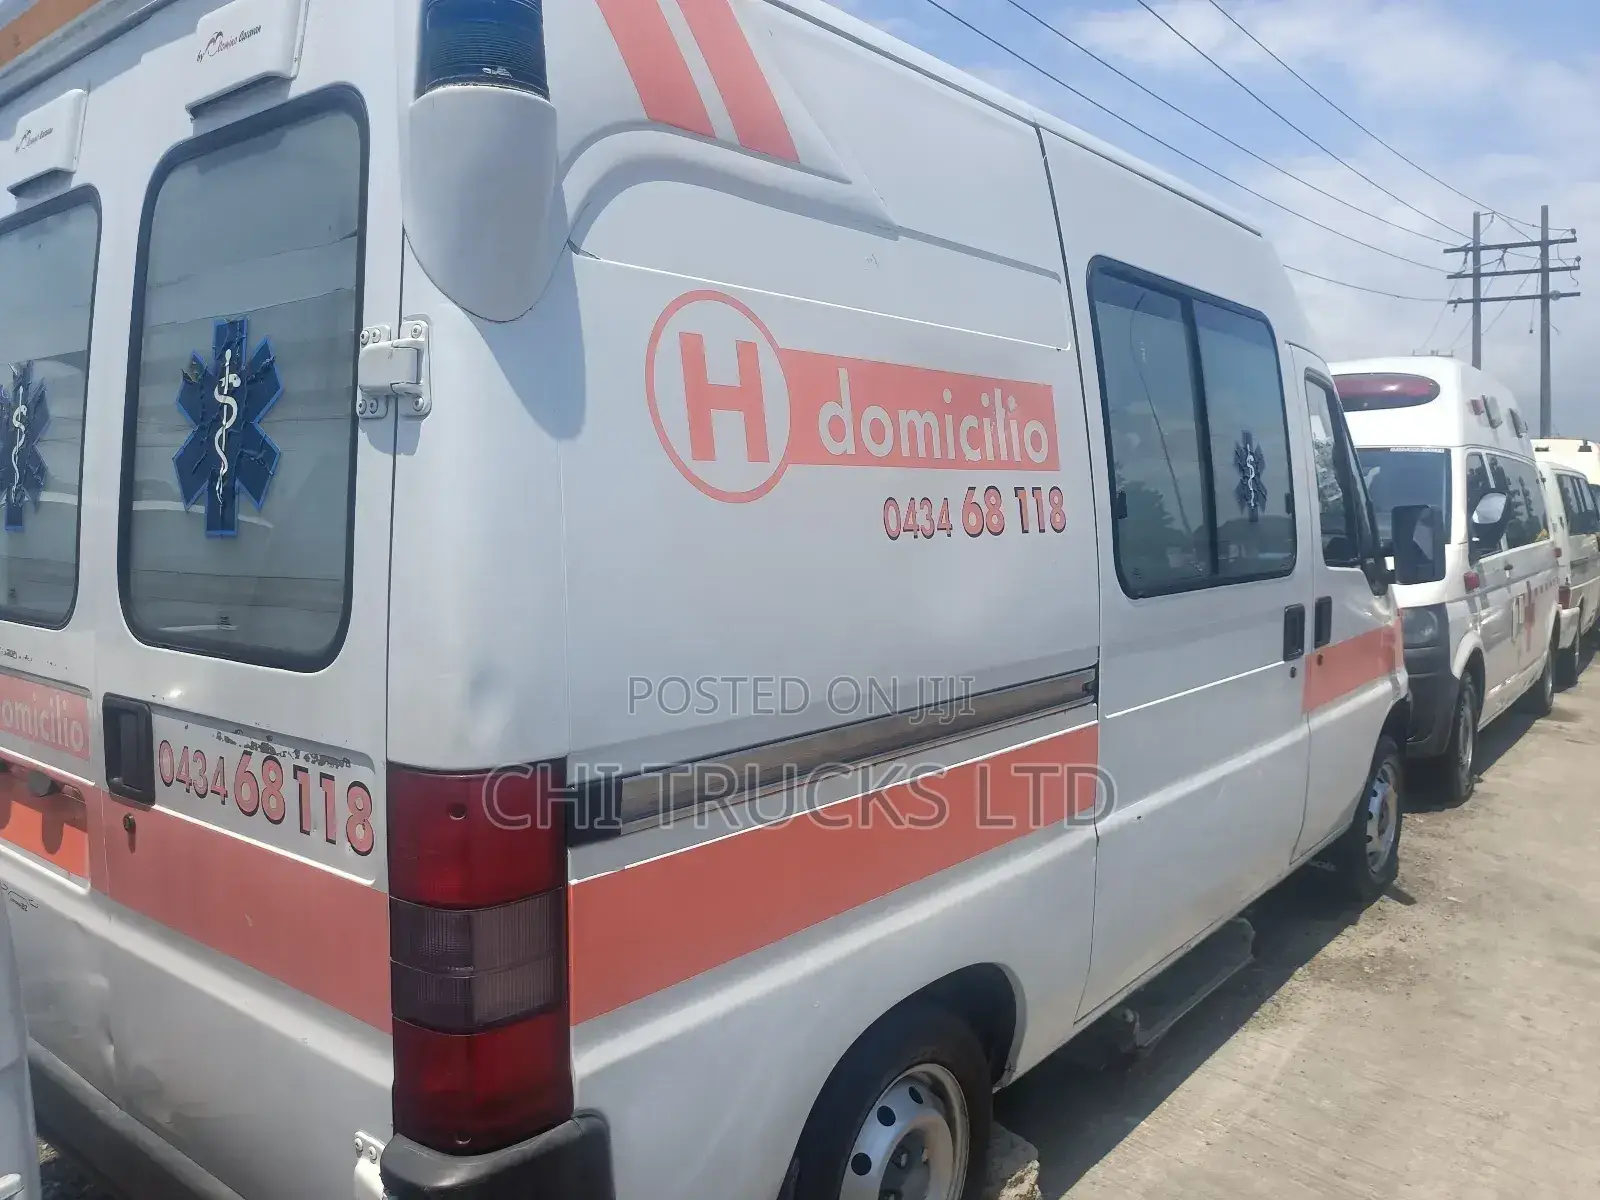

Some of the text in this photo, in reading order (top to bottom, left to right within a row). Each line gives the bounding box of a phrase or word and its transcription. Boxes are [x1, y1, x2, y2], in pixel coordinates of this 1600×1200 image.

[678, 331, 770, 463] H
[817, 367, 1049, 464] domicilio
[883, 485, 1067, 541] 0434 68 118
[158, 739, 375, 857] 0434 68 118
